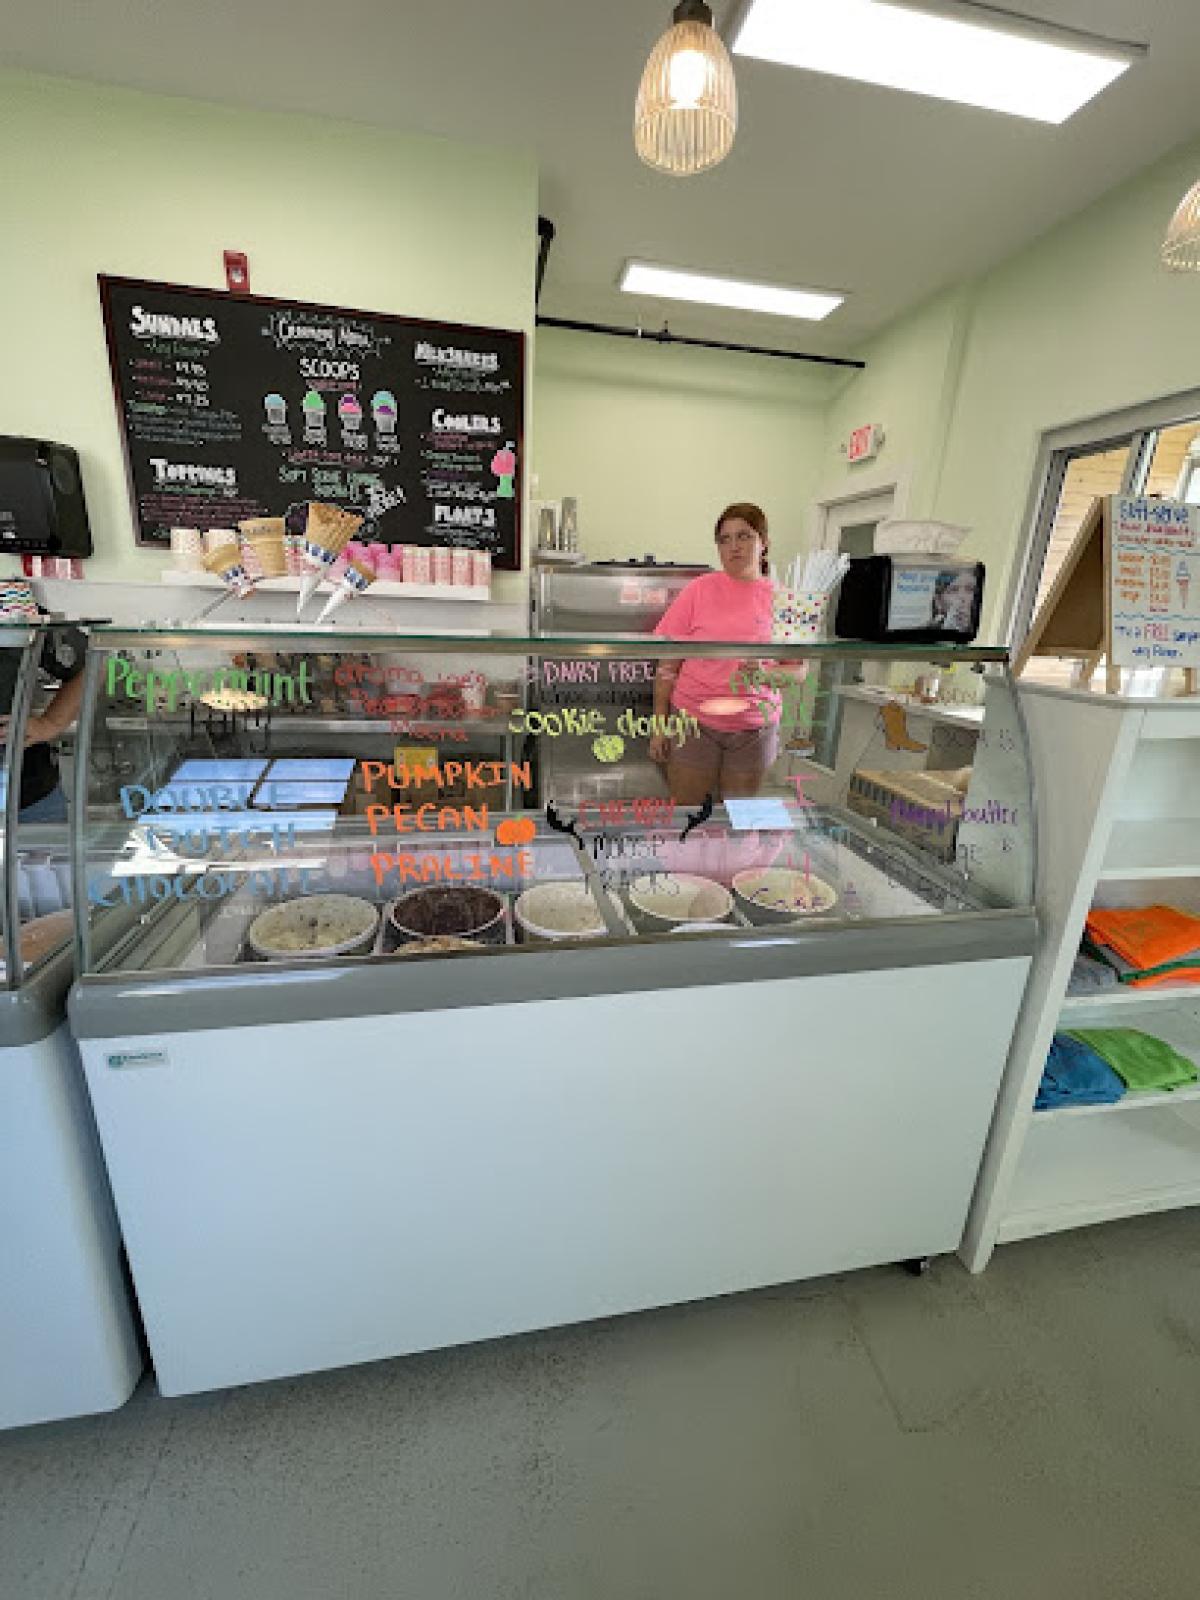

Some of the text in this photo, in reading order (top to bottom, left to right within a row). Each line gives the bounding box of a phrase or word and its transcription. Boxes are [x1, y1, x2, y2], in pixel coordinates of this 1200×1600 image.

[299, 357, 359, 380] SCOOPS
[106, 657, 313, 713] Peppermint
[544, 661, 655, 685] DAIRY FREE
[361, 761, 532, 793] PUMPKIN
[120, 784, 282, 818] DOUBLE
[364, 803, 489, 837] PECAN
[370, 850, 535, 887] PRALINE
